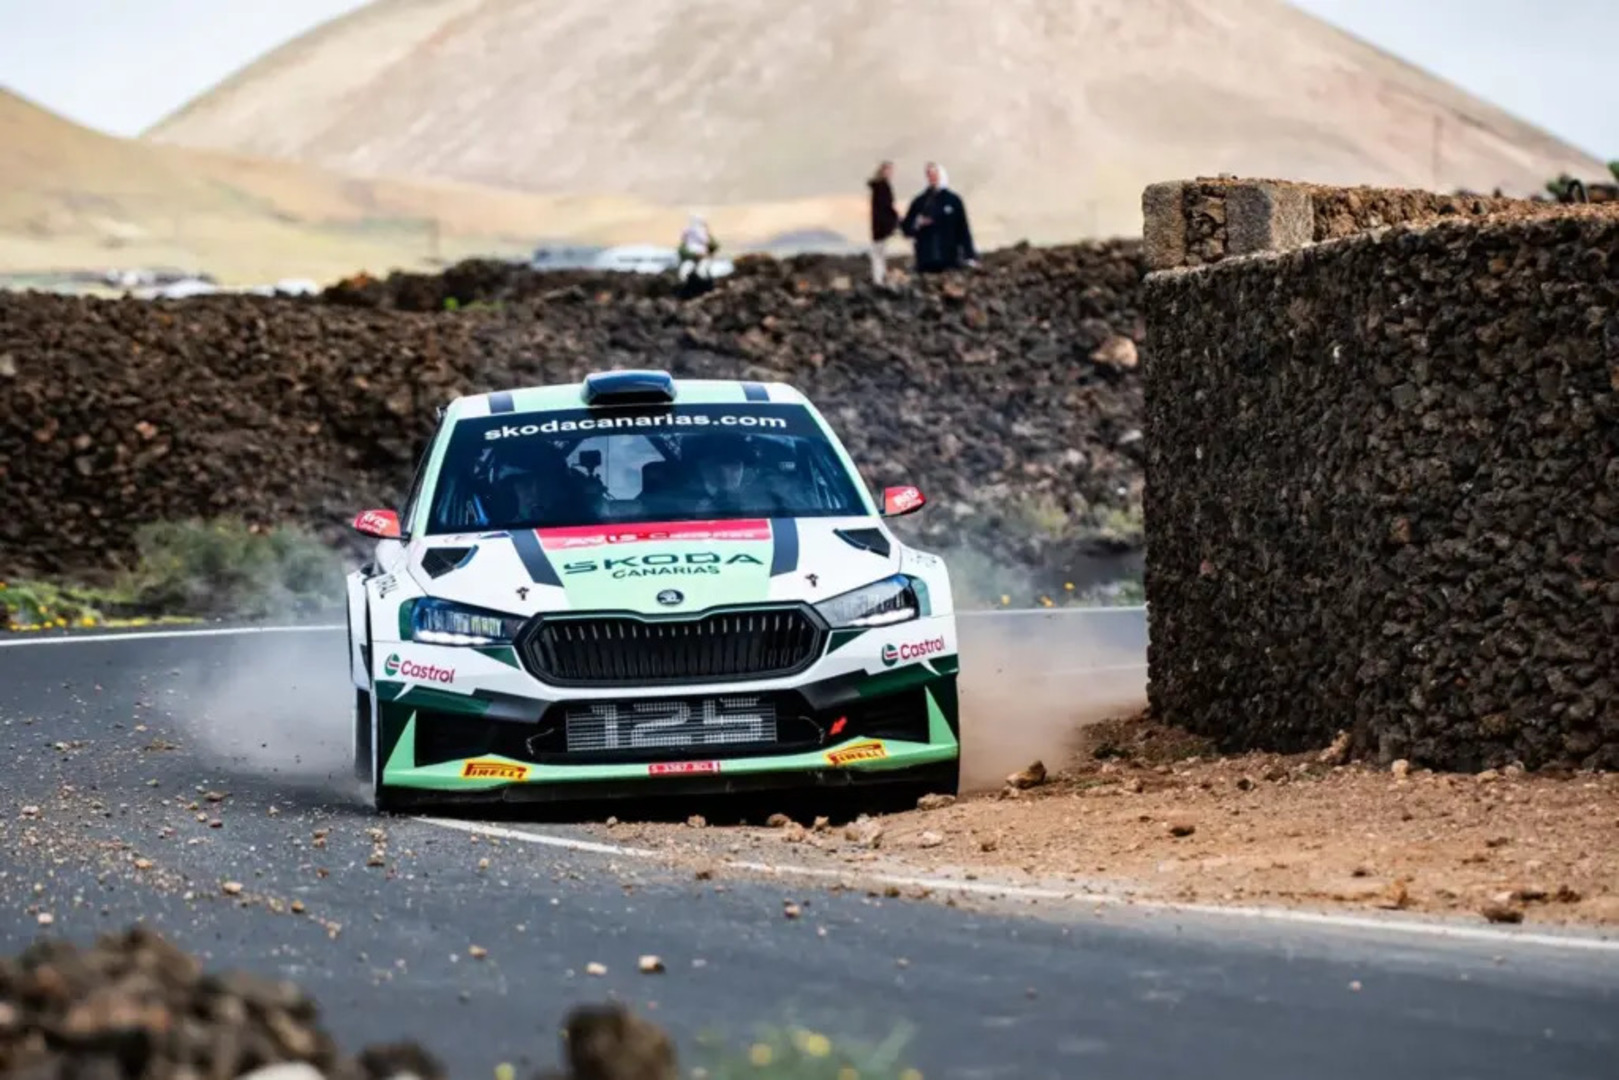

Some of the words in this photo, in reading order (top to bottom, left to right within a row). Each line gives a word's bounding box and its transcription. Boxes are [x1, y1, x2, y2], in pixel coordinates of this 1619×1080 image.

[484, 413, 787, 441] skodacanarias.com
[612, 565, 721, 579] CANARIAS
[900, 634, 946, 660] Castrol
[401, 659, 456, 684] Castrol
[589, 696, 764, 748] 125
[464, 763, 527, 779] PIRELLI
